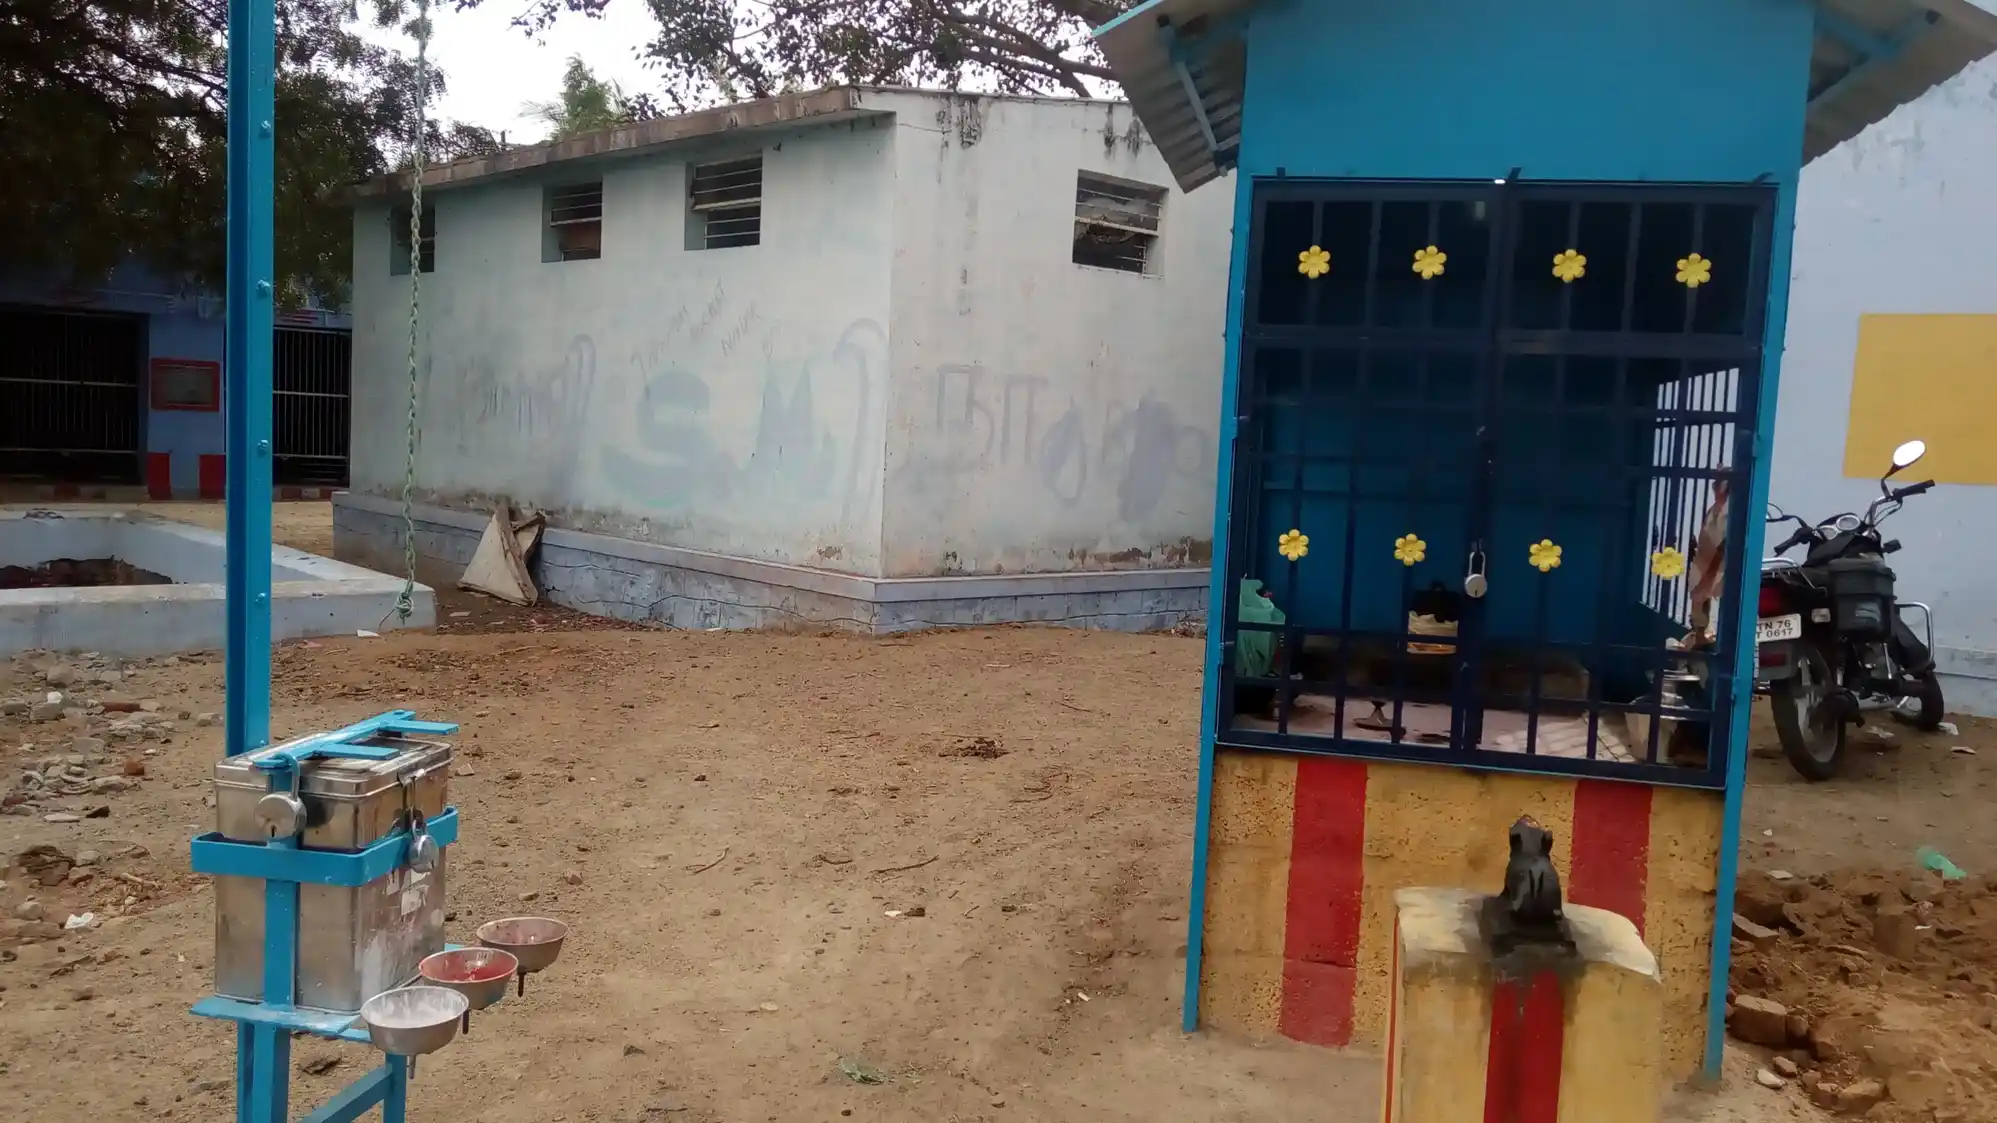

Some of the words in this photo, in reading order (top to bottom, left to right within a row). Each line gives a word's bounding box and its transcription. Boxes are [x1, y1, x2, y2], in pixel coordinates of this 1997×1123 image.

[1758, 622, 1773, 631] TN
[1777, 620, 1791, 629] 76
[1766, 628, 1793, 638] 0617
